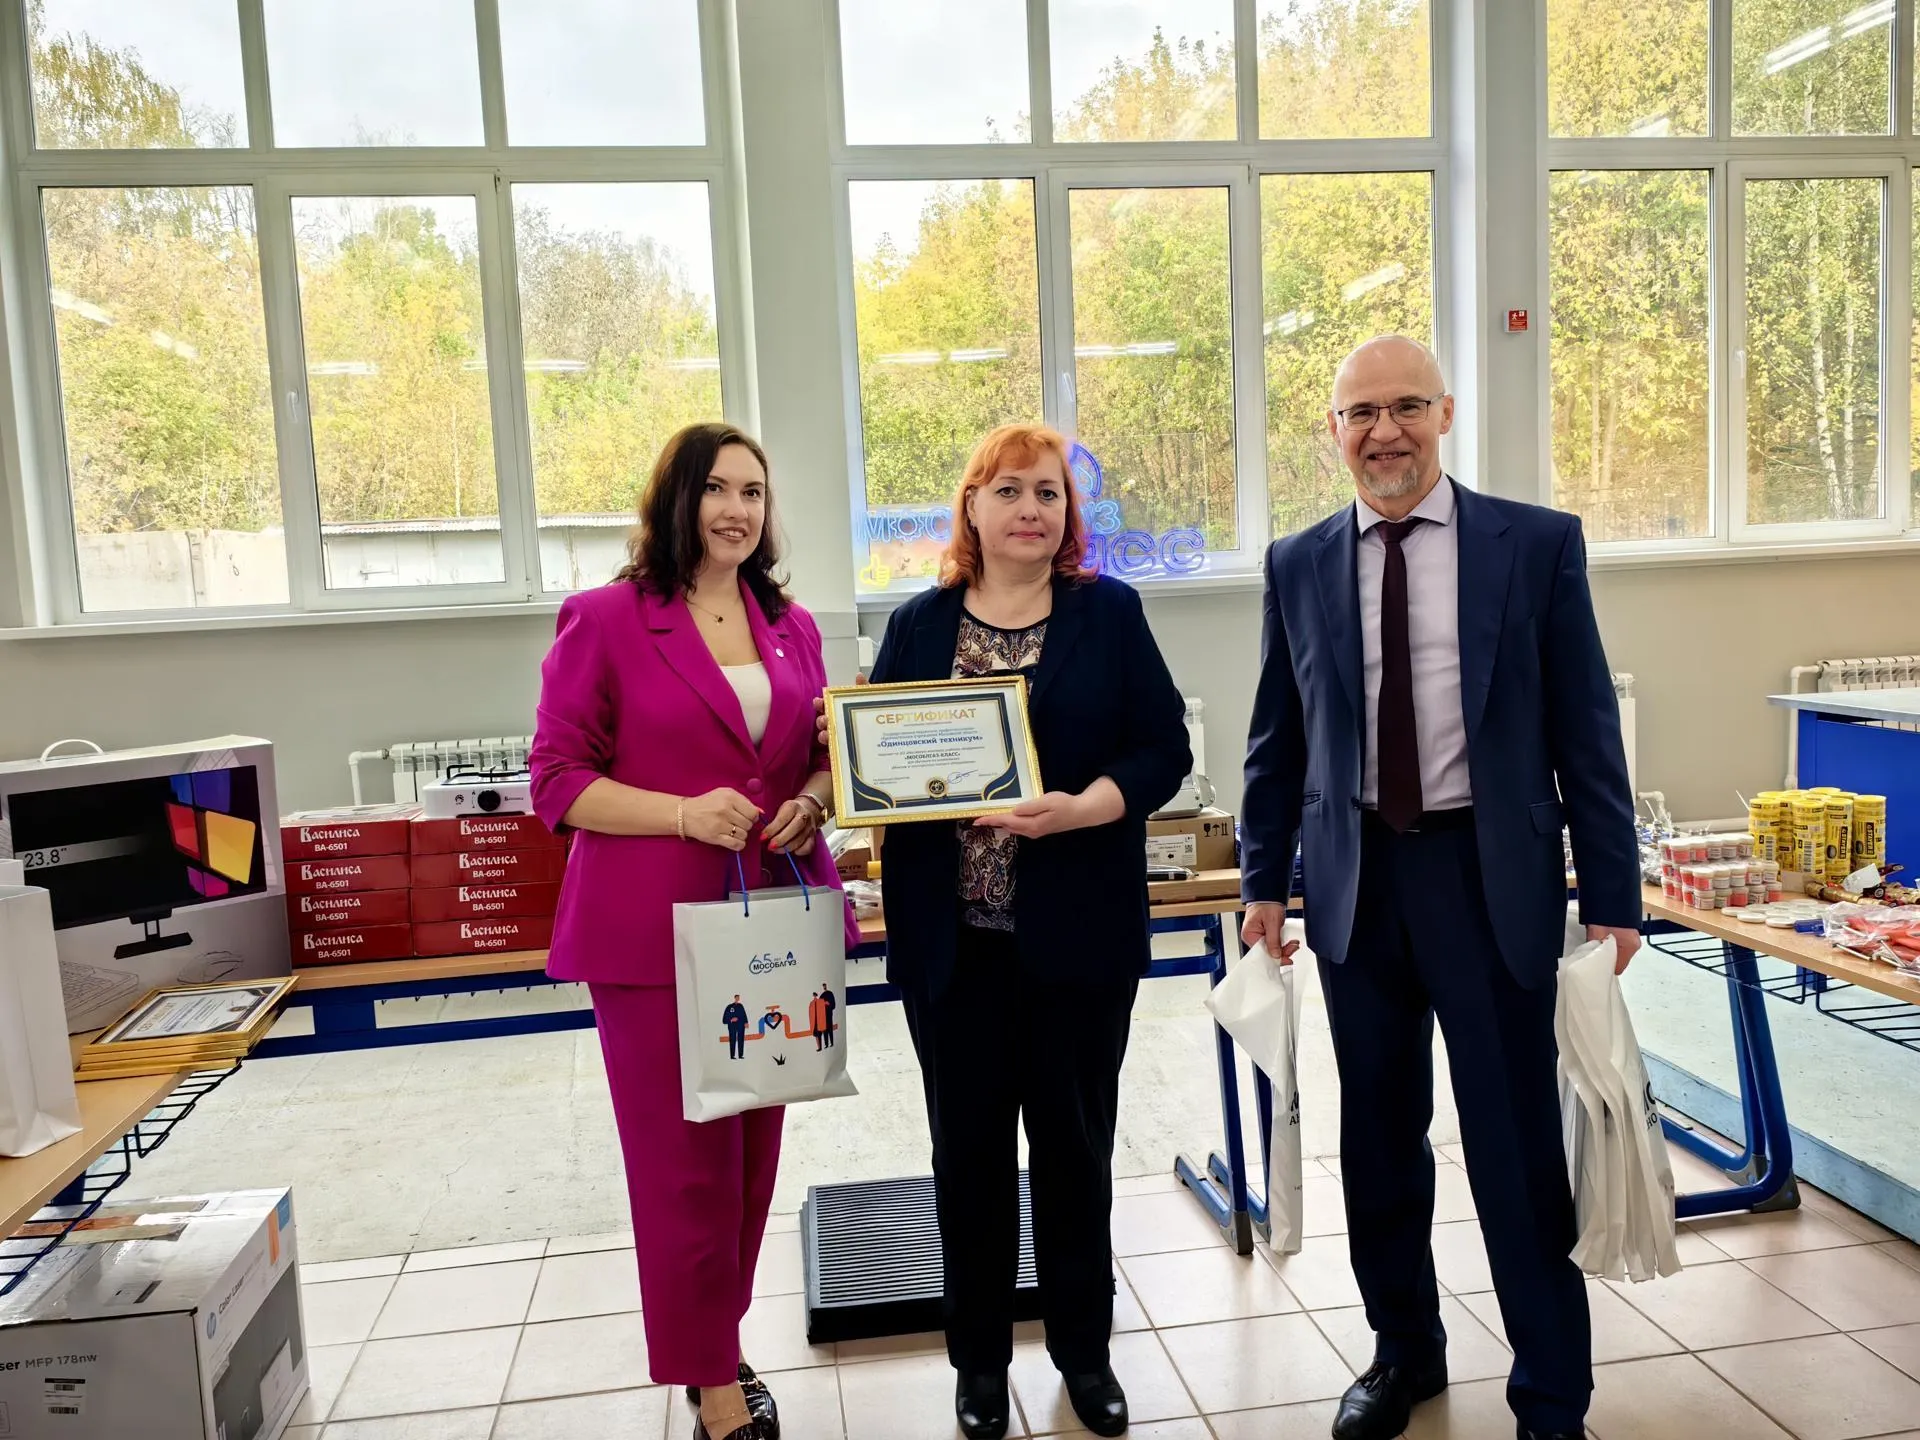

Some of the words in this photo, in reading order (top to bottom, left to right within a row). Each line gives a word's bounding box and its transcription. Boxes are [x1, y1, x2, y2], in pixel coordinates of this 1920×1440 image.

[875, 708, 977, 725] СЕРТИФИКАТ
[300, 826, 361, 843] Василиса
[460, 819, 519, 835] Василиса
[314, 842, 348, 852] ВА-6501
[474, 836, 507, 844] ВА-6501
[459, 853, 518, 869] Василиса
[301, 864, 362, 881] Василиса
[472, 869, 505, 878] ВА-6501
[315, 879, 349, 889] ВА-6501
[459, 886, 517, 902] Василиса
[301, 896, 361, 913] Василиса
[472, 902, 505, 911] ВА-6501
[315, 912, 349, 921] ВА-6501
[460, 923, 519, 939] Василиса
[303, 933, 364, 950] Василиса
[474, 938, 507, 948] ВА-6501
[318, 949, 351, 959] ВА-6501
[25, 1357, 54, 1369] MFP
[57, 1354, 97, 1366] 178nw
